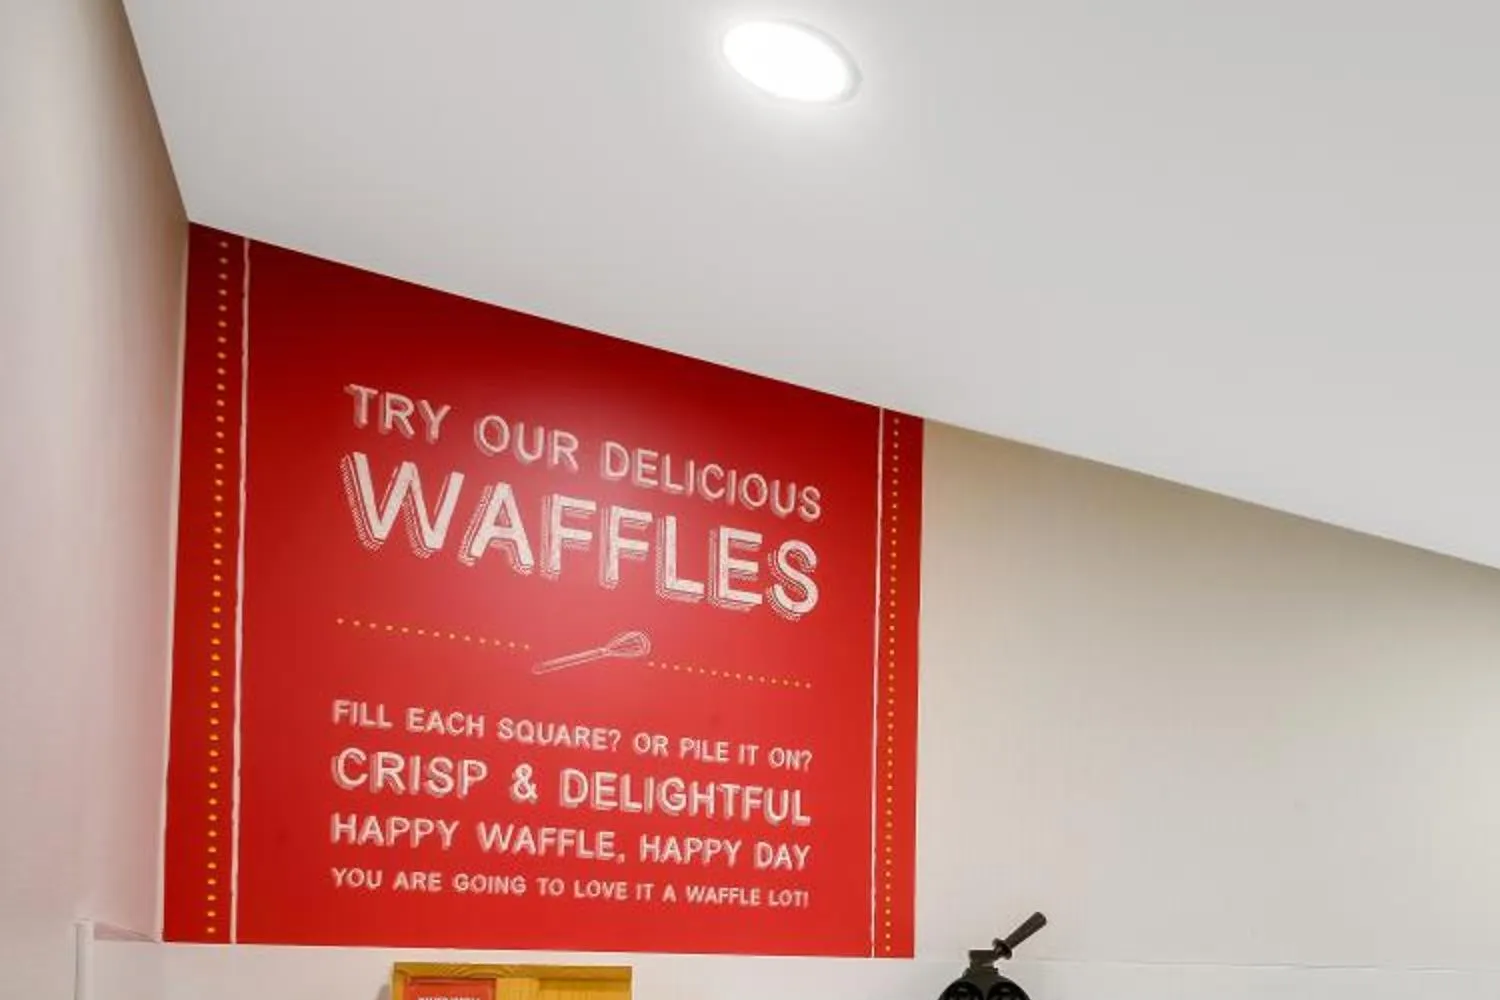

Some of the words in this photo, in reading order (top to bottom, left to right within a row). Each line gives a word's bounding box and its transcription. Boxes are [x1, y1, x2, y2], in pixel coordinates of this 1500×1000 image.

[344, 383, 451, 443] TRY
[474, 414, 580, 471] OUR
[603, 440, 822, 521] DELICIOUS
[340, 451, 819, 620] WAFFLES
[332, 699, 393, 729] FILL
[406, 707, 485, 738] EACH
[498, 718, 621, 751] SQUARE?
[634, 732, 669, 756] OR
[680, 738, 730, 762] PILE
[738, 745, 760, 766] IT
[768, 747, 813, 773] ON?
[331, 747, 488, 799] CRISP
[511, 763, 538, 803] &
[559, 768, 812, 827] DELIGHTFUL
[331, 813, 460, 850] HAPPY
[477, 822, 626, 864] WAFFLE,
[640, 834, 742, 868] HAPPY
[754, 842, 811, 870] DAY
[332, 867, 383, 889] YOU
[393, 871, 443, 892] ARE
[453, 874, 527, 896] GOING
[536, 877, 565, 896] TO
[574, 880, 629, 900] LOVE
[636, 883, 655, 901] IT
[661, 885, 677, 903] A
[686, 885, 762, 906] WAFFLE
[768, 890, 809, 909] LOT!
